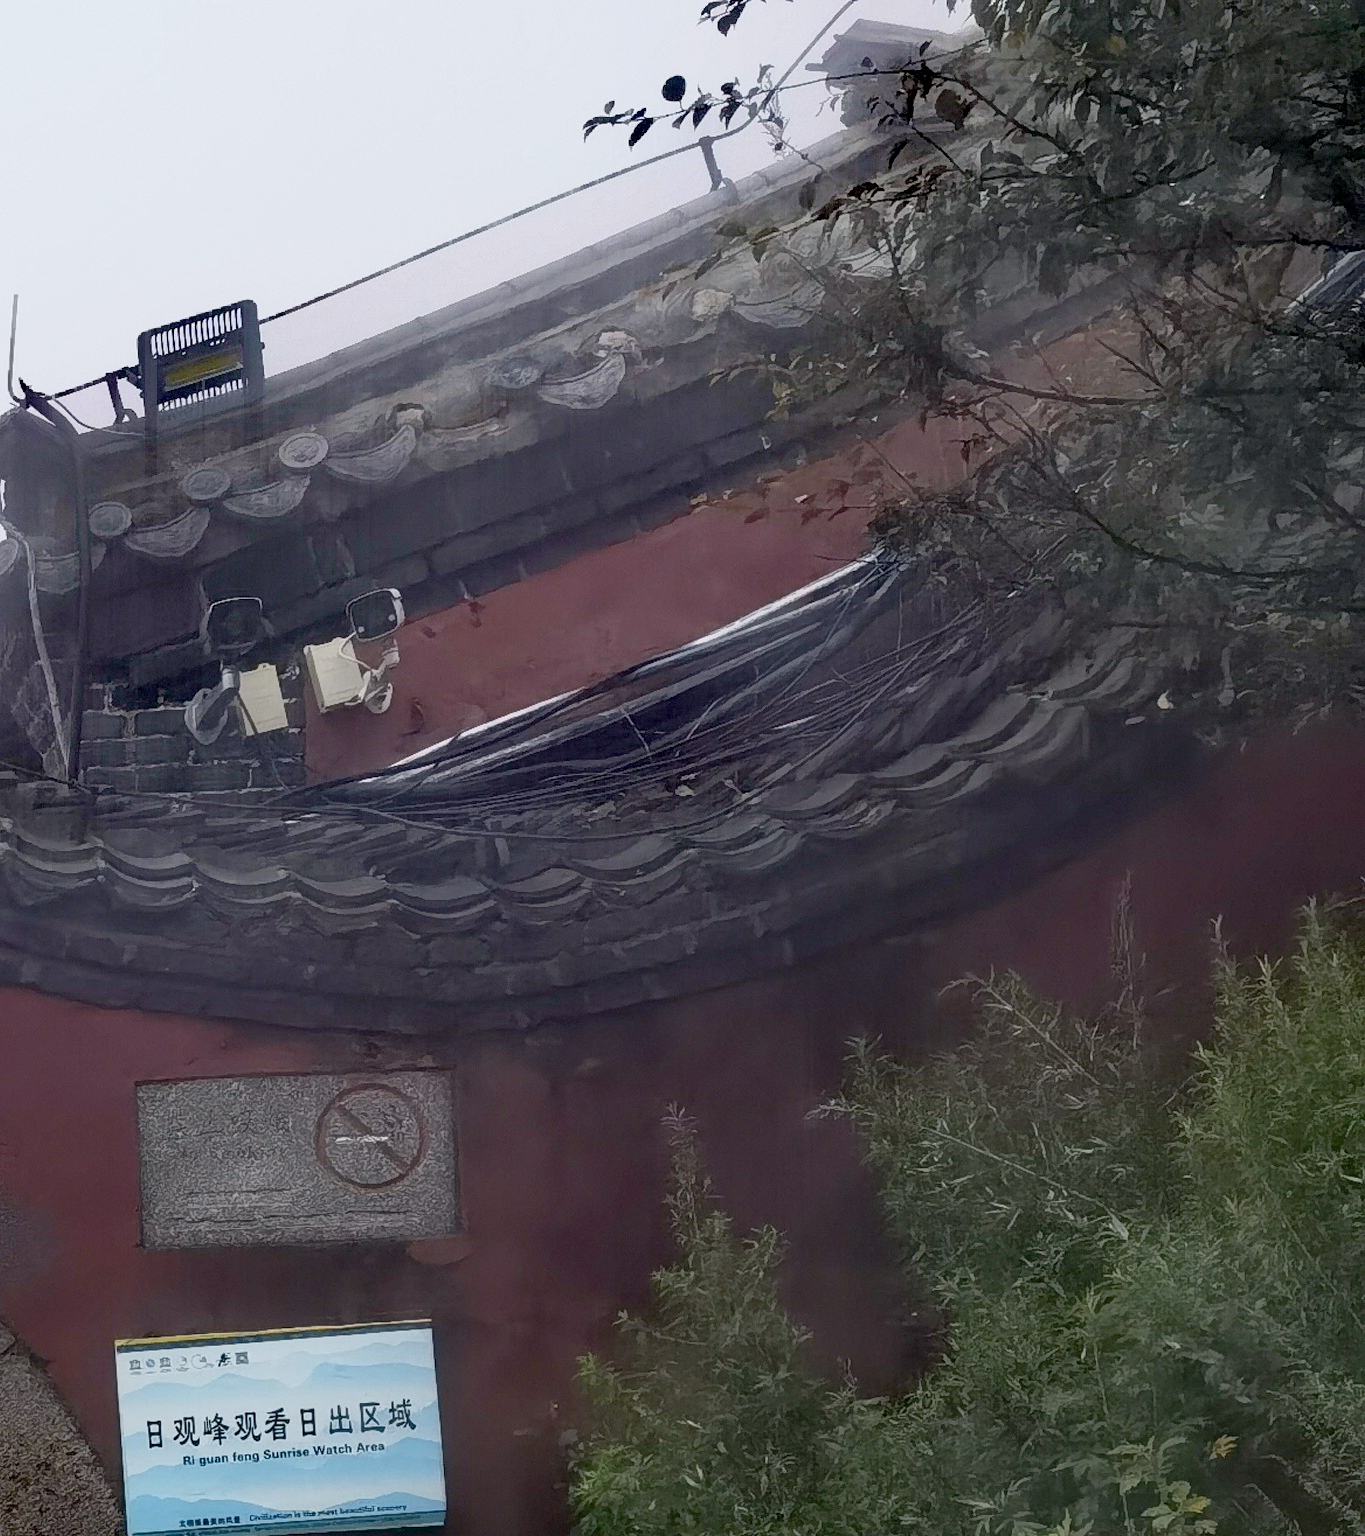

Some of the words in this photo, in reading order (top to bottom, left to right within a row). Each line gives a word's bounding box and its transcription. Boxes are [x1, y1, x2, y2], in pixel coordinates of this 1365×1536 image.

[146, 1398, 417, 1449] 日观峰观看日出区域
[182, 1455, 195, 1466] Ri
[198, 1455, 229, 1467] guan
[232, 1451, 260, 1463] feng
[263, 1447, 310, 1460] Sunrise
[312, 1443, 352, 1456] Watch
[356, 1441, 385, 1452] Area
